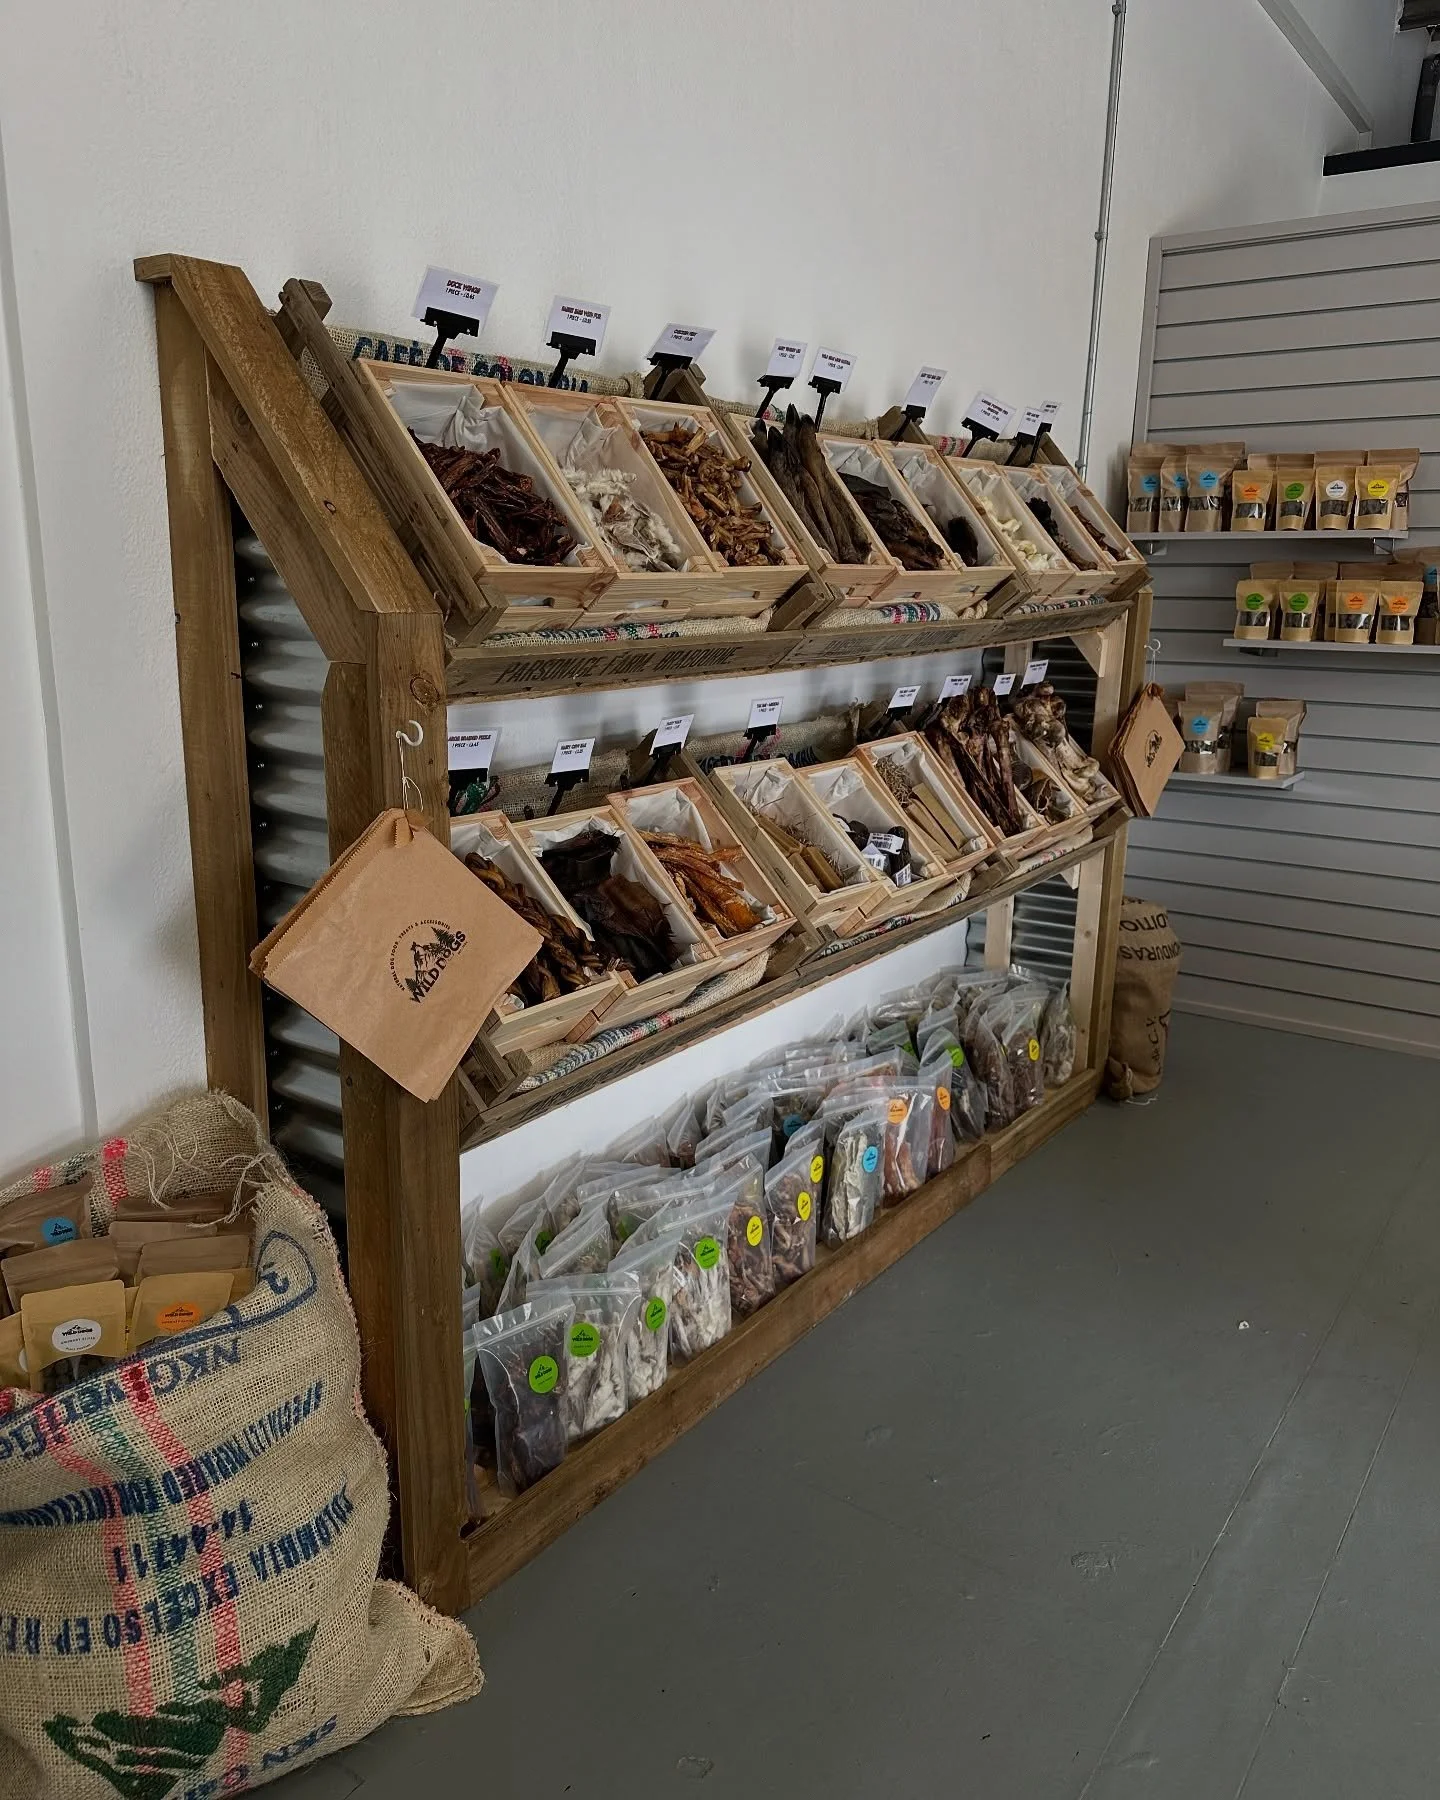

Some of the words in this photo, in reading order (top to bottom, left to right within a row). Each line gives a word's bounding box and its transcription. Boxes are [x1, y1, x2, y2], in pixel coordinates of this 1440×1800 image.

[489, 656, 608, 685] PARSONAGE
[1118, 913, 1168, 931] DITIO
[409, 967, 440, 1004] WILD
[436, 930, 466, 970] DOGS
[1118, 942, 1180, 961] ONDURAS
[149, 1336, 242, 1396] NKG
[250, 1484, 354, 1582] COLOMBIA
[103, 1561, 240, 1650] EXCELSO
[0, 1616, 41, 1655] RF
[55, 1616, 91, 1655] EP
